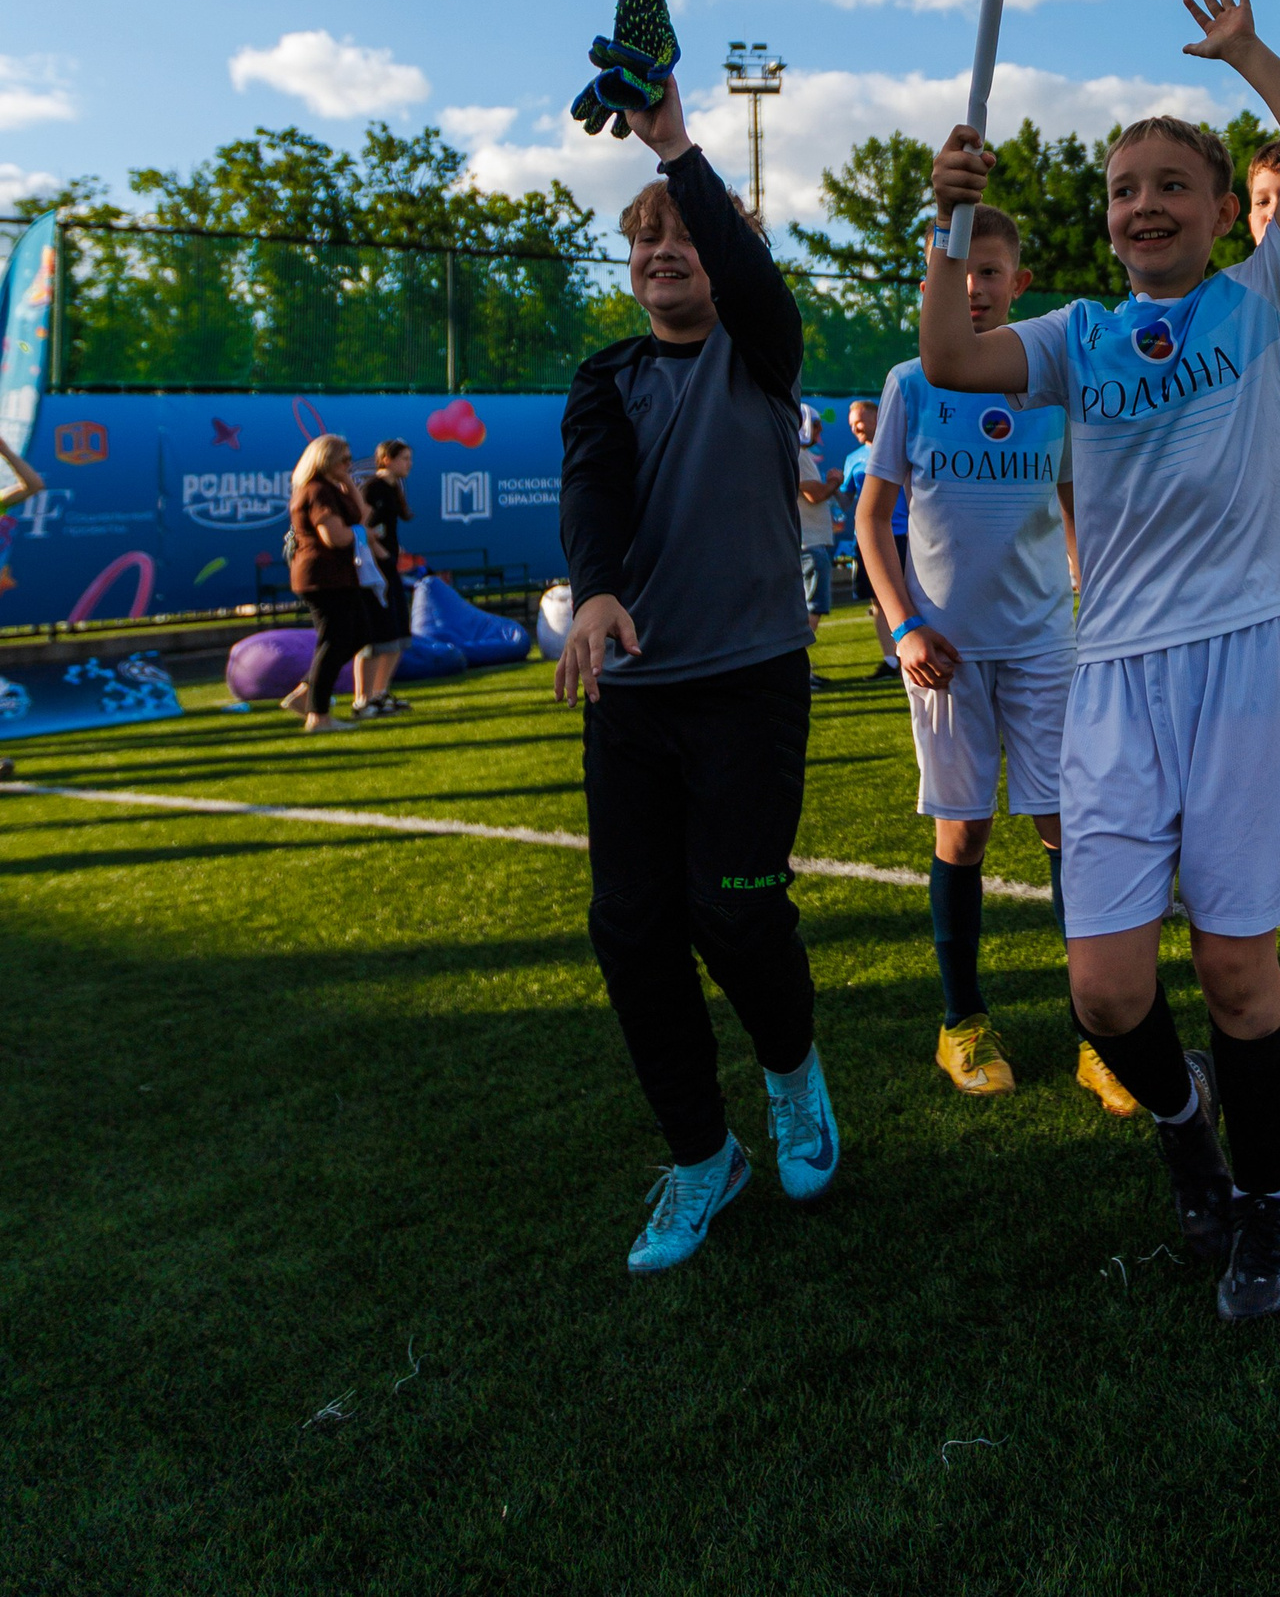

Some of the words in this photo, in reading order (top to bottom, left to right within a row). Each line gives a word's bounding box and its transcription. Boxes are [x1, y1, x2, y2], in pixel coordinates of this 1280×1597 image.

[1081, 346, 1241, 423] РОДИНА
[930, 450, 1054, 482] РОДИНА
[497, 492, 561, 507] ОБРАЗОВА
[721, 874, 777, 889] KELME
